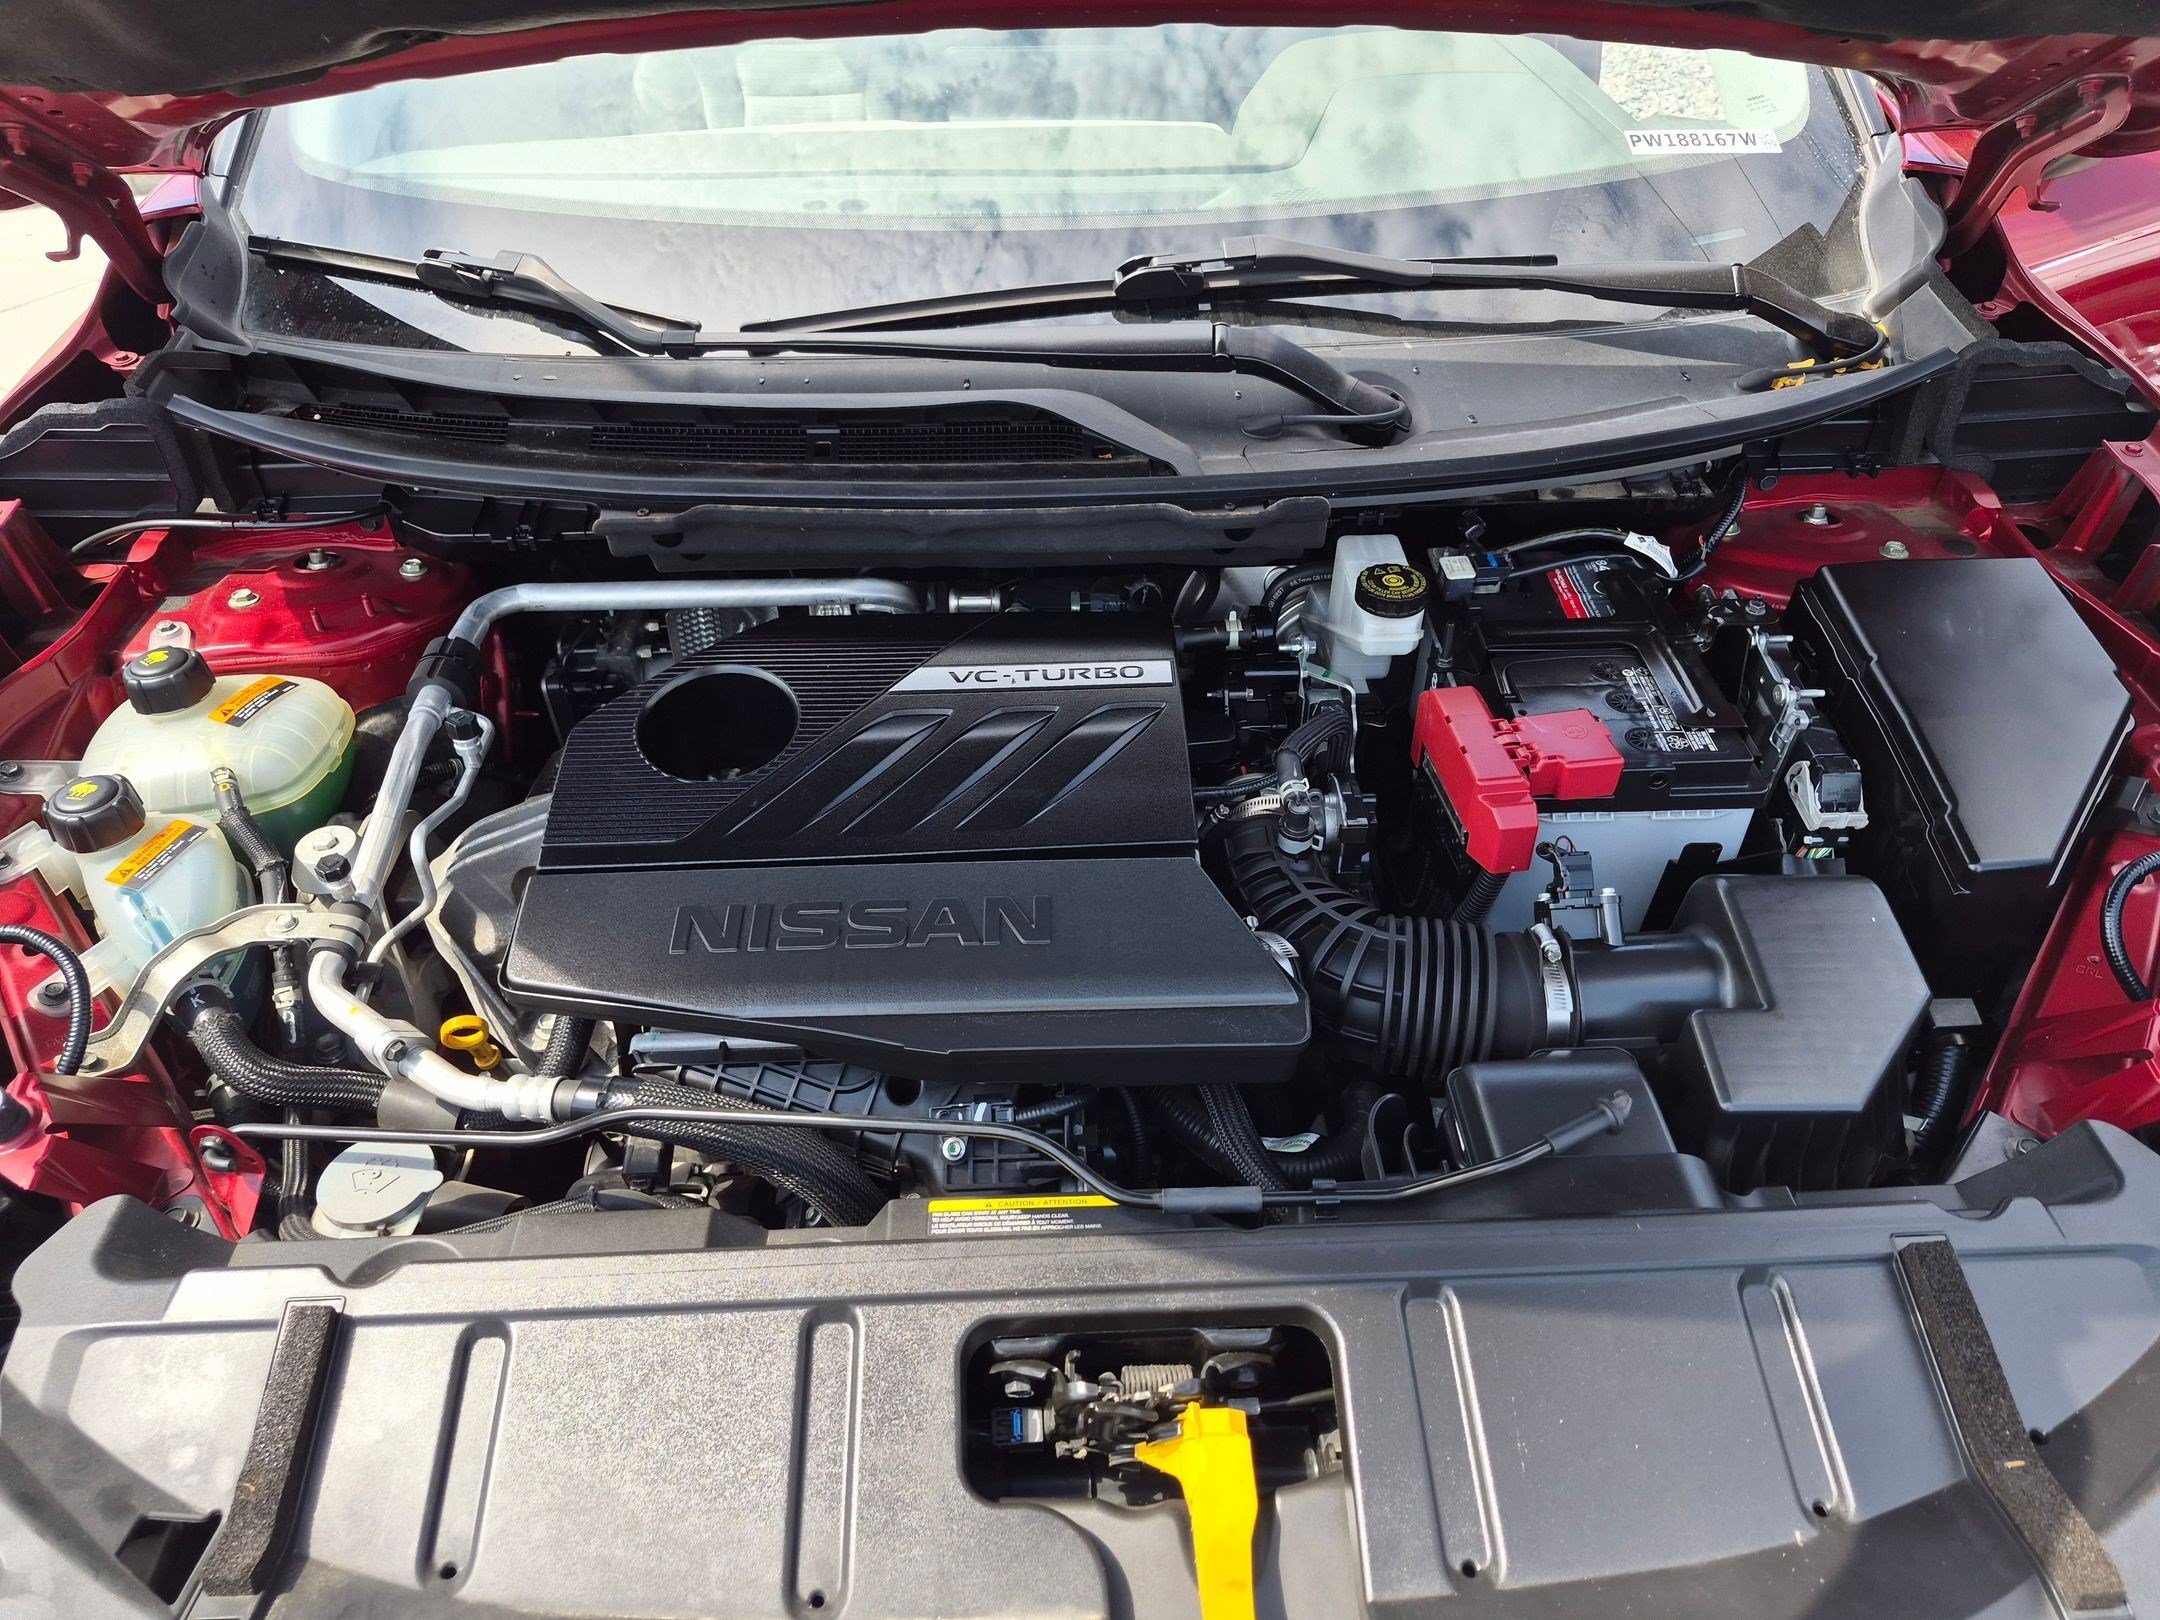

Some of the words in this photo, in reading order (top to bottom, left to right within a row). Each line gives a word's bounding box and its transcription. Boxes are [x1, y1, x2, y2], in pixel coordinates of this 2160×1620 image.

[1629, 132, 1757, 147] PW188167W
[948, 665, 1144, 686] VC-TURBO
[669, 894, 1052, 955] NISSAN
